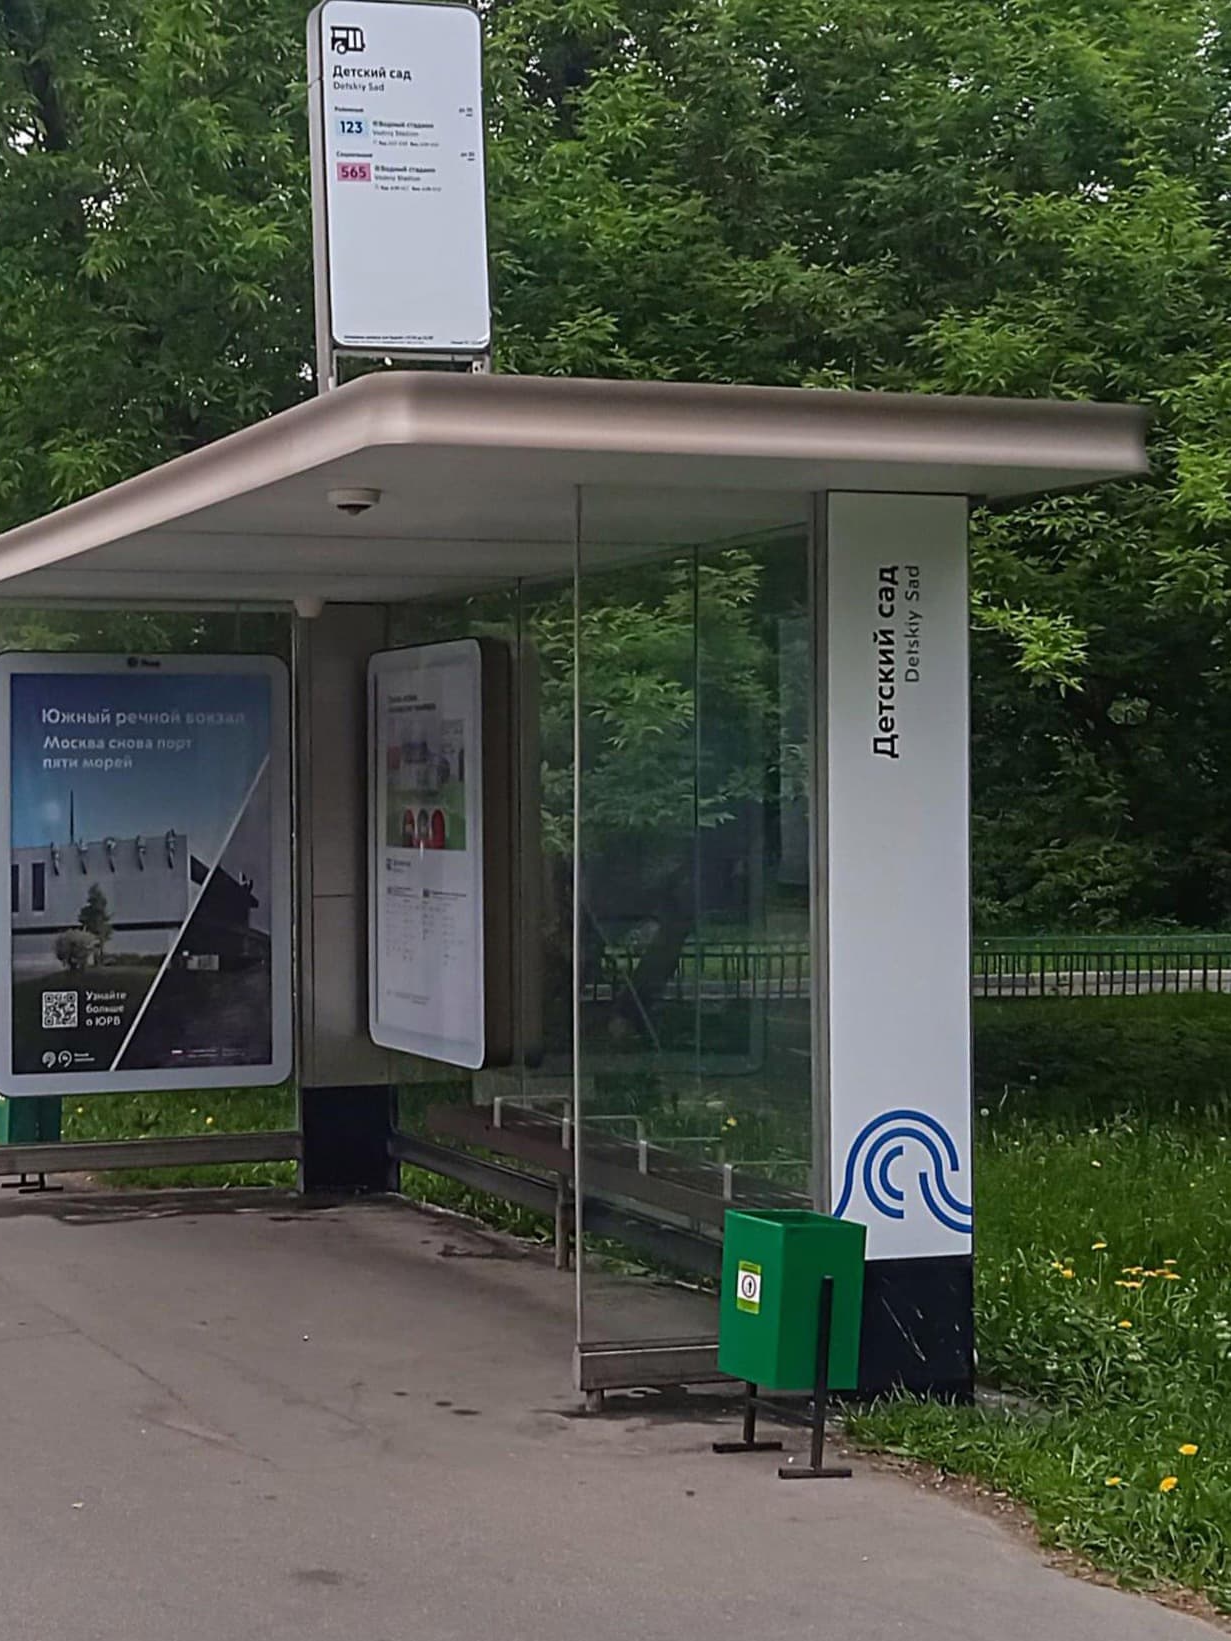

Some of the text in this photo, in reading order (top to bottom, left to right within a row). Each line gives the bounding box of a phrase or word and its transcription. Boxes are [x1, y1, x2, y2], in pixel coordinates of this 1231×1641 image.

[332, 65, 412, 81] Детский сад
[340, 121, 363, 134] 123
[341, 166, 367, 179] 565
[904, 565, 923, 683] Detskiy Sad
[873, 565, 900, 759] Детский сад
[41, 708, 111, 725] Южный
[115, 710, 182, 727] речной
[43, 736, 193, 752] Москва снова порт
[43, 754, 133, 771] пяти морей
[85, 990, 127, 1000] Узнайте
[85, 1003, 124, 1014] больше
[85, 1015, 121, 1026] о ЮРВ
